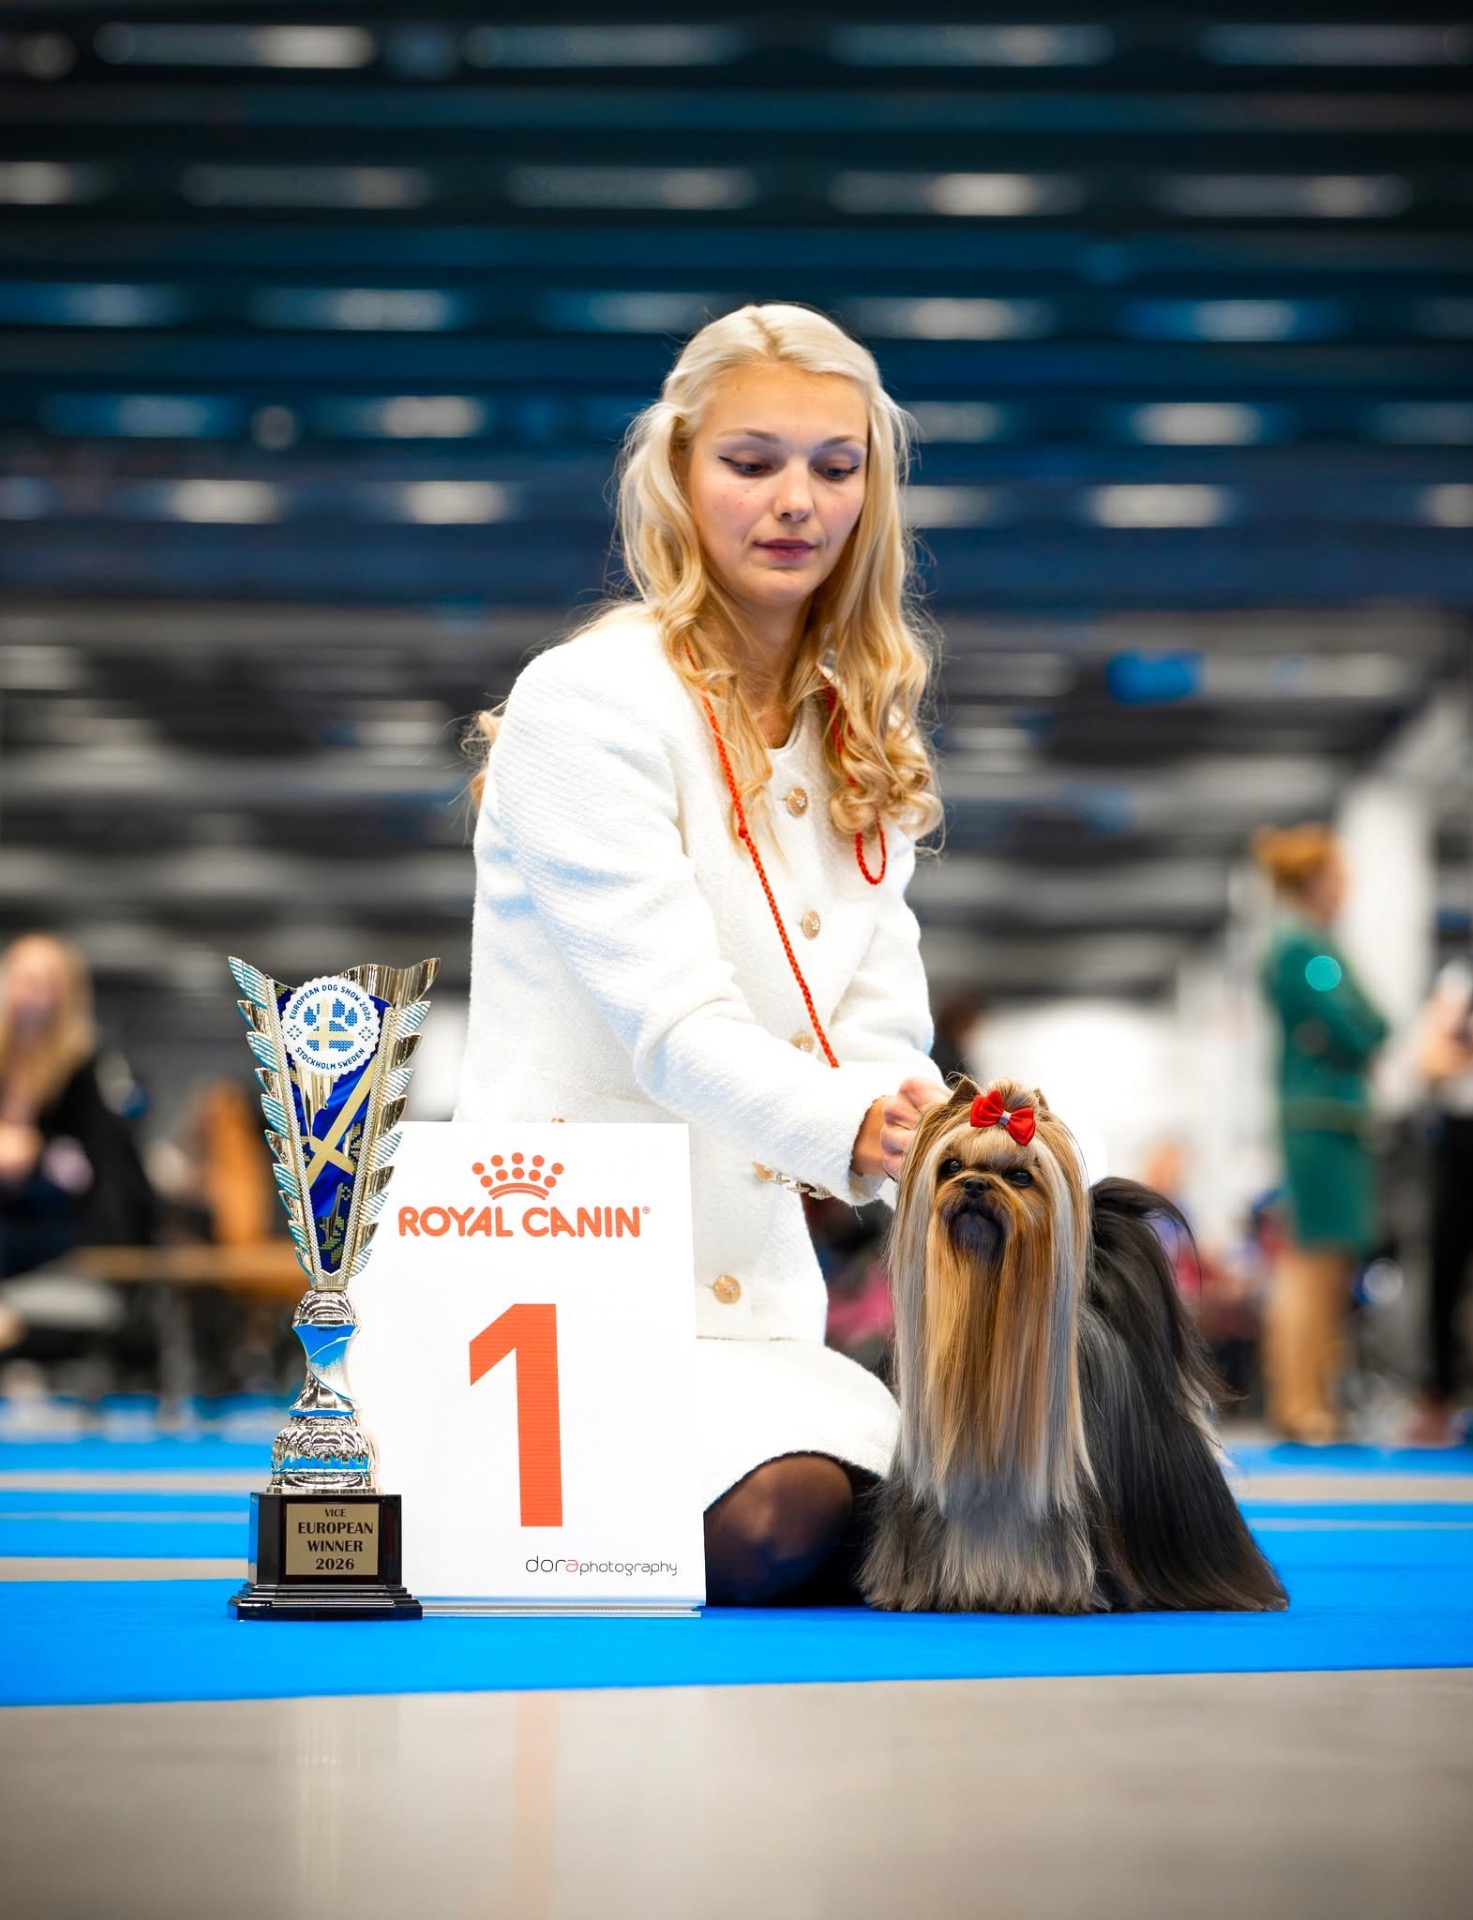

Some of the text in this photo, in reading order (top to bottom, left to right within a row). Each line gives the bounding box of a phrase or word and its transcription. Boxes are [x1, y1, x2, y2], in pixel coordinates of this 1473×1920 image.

[289, 986, 319, 1020] EUROPEAN
[340, 986, 361, 1002] SHOW
[359, 1001, 372, 1021] 2026
[295, 1046, 366, 1070] STOCKHOLM SWEDEN
[398, 1206, 514, 1237] ROYAL
[469, 1303, 563, 1527] 1
[324, 1508, 346, 1517] VICE
[297, 1522, 374, 1534] EUROPEAN
[307, 1540, 363, 1552] WINNER
[315, 1558, 355, 1570] 2026
